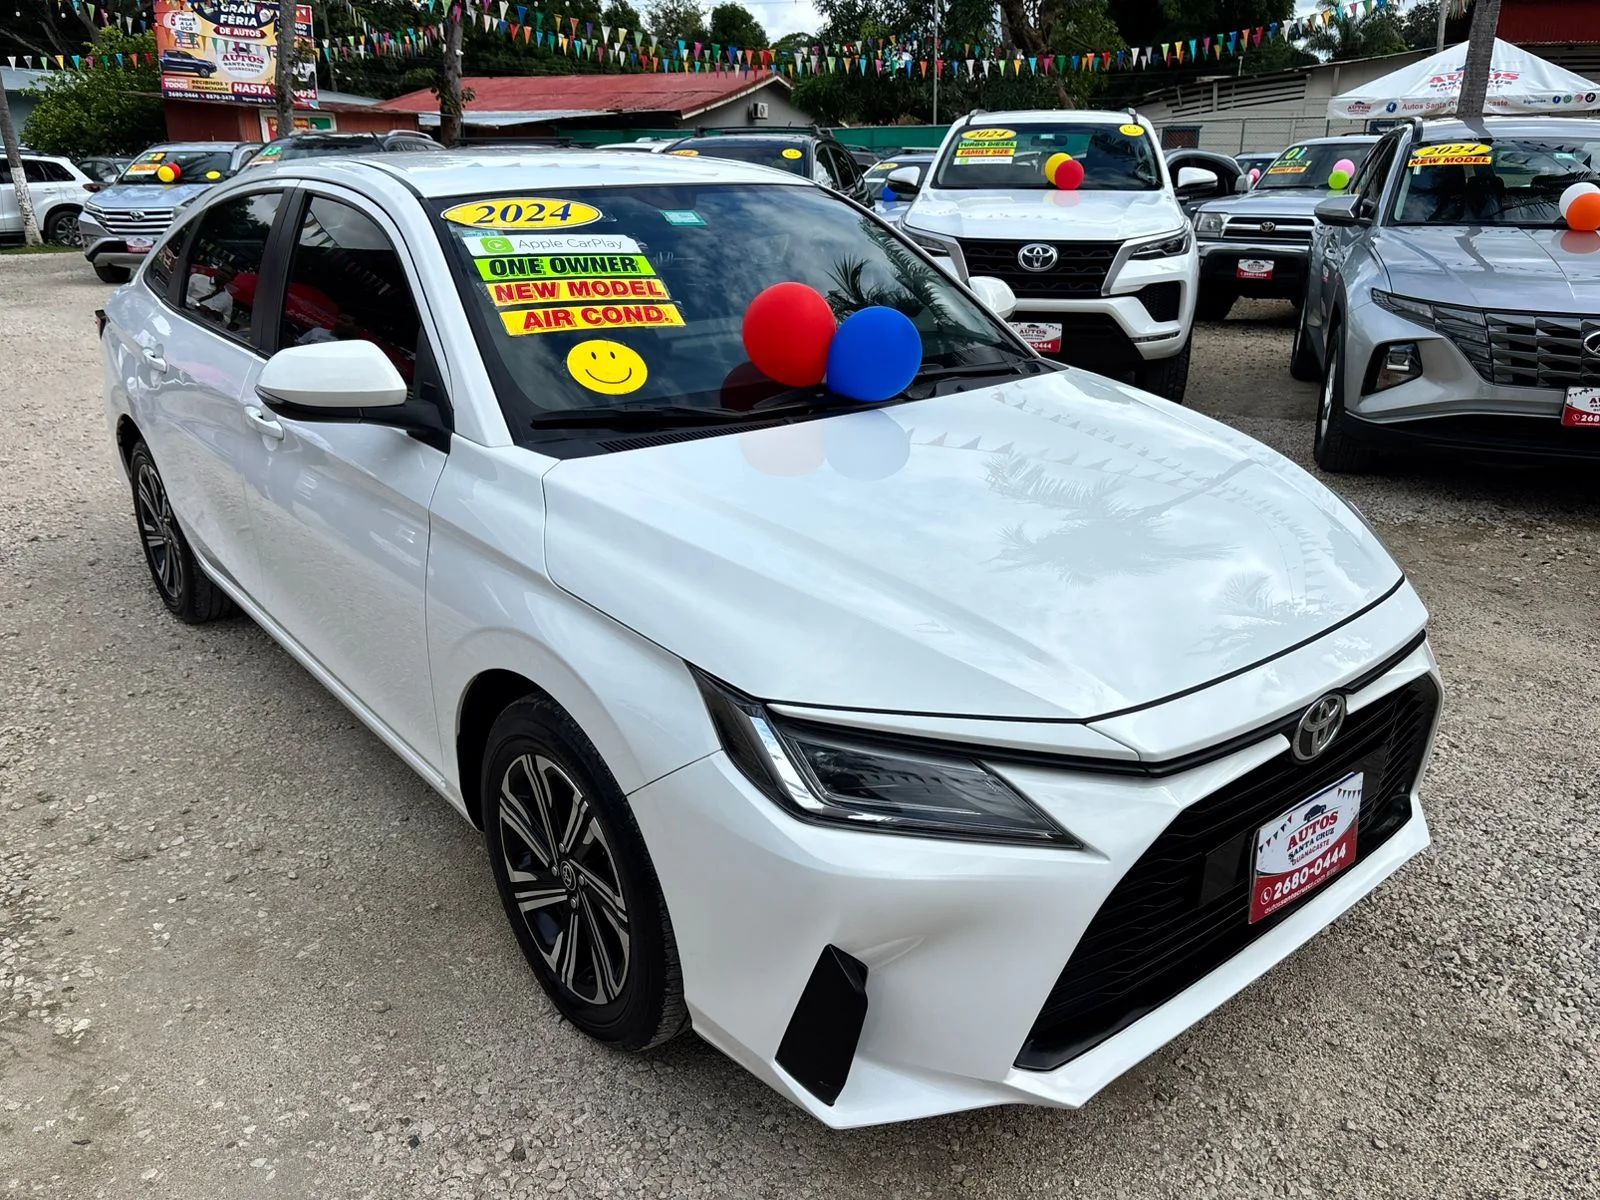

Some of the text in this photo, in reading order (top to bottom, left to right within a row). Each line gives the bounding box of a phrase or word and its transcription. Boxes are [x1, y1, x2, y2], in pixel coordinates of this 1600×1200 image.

[220, 4, 256, 14] GRAN
[219, 26, 262, 38] DE AUTOS
[222, 53, 265, 64] AUTOS
[163, 81, 188, 89] TODOS
[234, 82, 272, 95] HASTA
[1402, 103, 1424, 111] Autos
[969, 130, 1009, 139] 2024
[1424, 145, 1479, 156] 2024
[1410, 158, 1442, 166] NEW
[473, 203, 572, 224] 2024
[518, 237, 623, 251] Apple CarPlay
[489, 256, 640, 277] ONE OWNER
[494, 280, 665, 302] NEW MODEL
[523, 305, 672, 330] AIR COND.
[1286, 810, 1339, 852] AUTOS
[1288, 827, 1336, 859] SANTA CRUZ
[1291, 838, 1331, 866] GUANACASTE
[1273, 842, 1347, 901] 2680-0444
